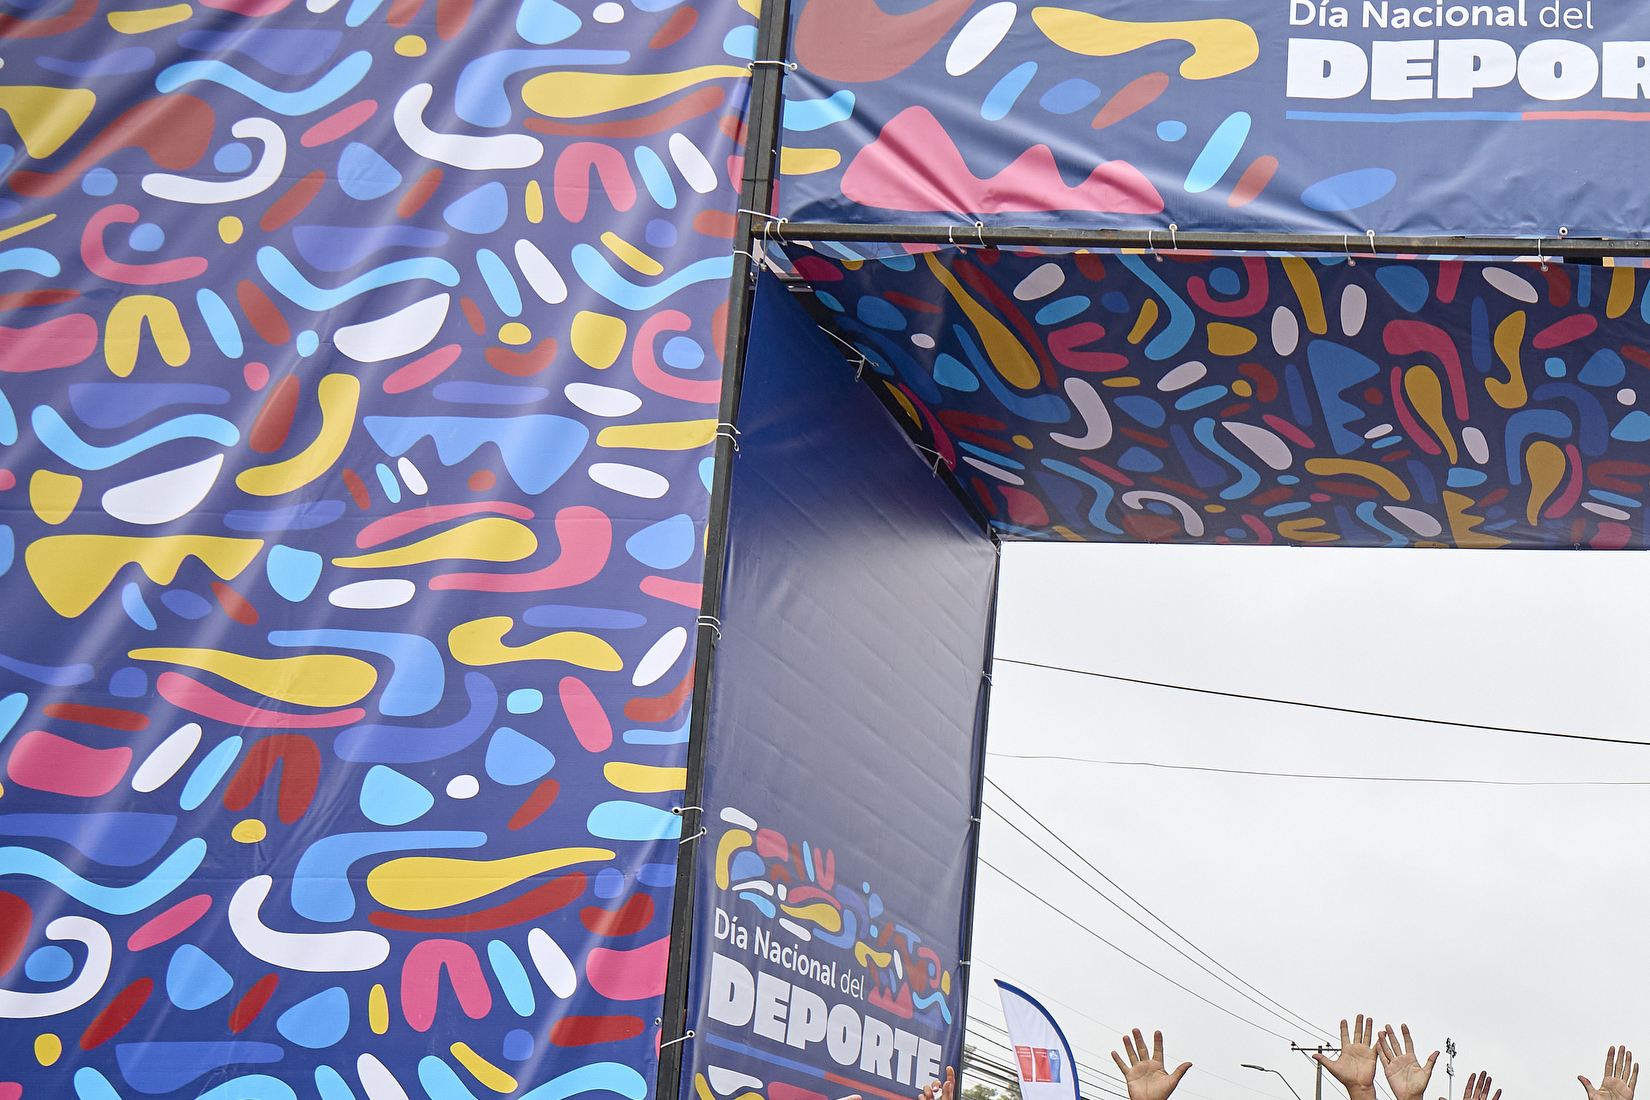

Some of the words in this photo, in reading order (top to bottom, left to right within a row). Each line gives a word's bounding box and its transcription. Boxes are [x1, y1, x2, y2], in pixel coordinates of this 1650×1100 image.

[1289, 0, 1348, 27] Día
[1362, 0, 1528, 29] Nacional
[1539, 1, 1594, 29] del
[714, 907, 748, 950] Día
[754, 926, 836, 988] Nacional
[840, 969, 864, 1001] del
[708, 952, 942, 1090] DEPORTE
